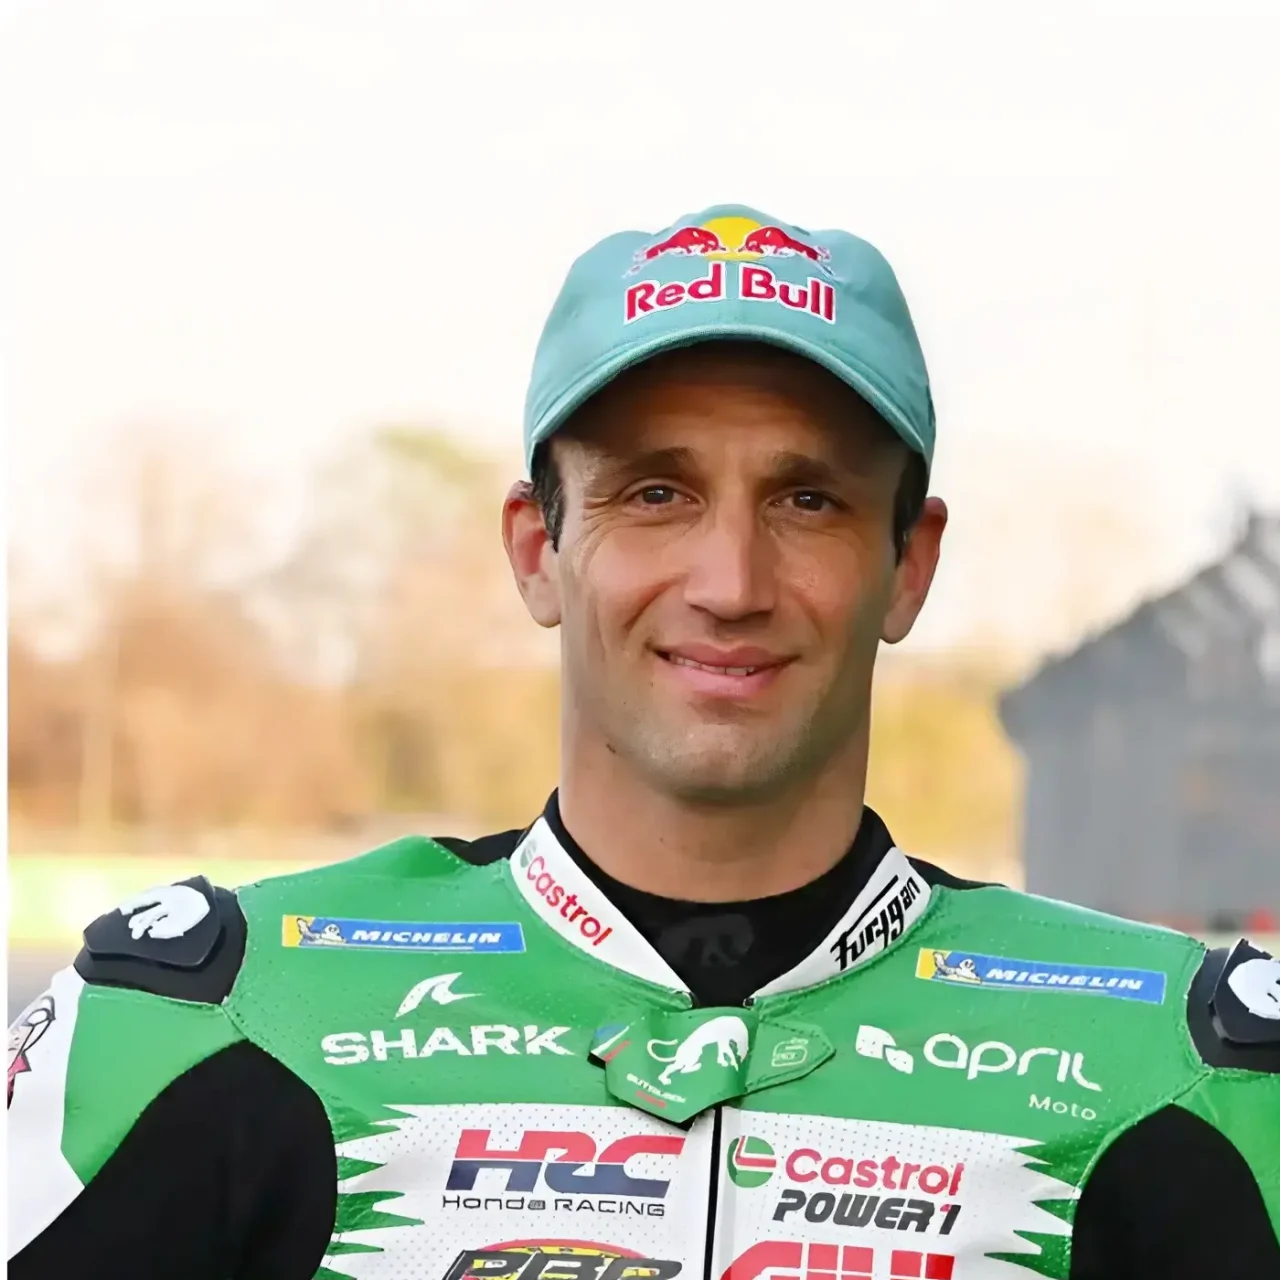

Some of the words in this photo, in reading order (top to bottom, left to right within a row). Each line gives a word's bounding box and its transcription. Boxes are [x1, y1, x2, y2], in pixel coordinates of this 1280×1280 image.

[624, 262, 726, 324] Red
[738, 262, 836, 324] Bull
[527, 855, 613, 946] Castrol
[352, 929, 502, 946] MICHELIN
[985, 966, 1145, 992] MICHELIN
[321, 1025, 577, 1065] SHARK
[1029, 1094, 1097, 1121] Moto
[445, 1129, 686, 1199] HRC
[785, 1148, 965, 1196] Castrol
[442, 1195, 547, 1211] Honda
[554, 1198, 666, 1217] RACING
[773, 1189, 962, 1236] POWER1
